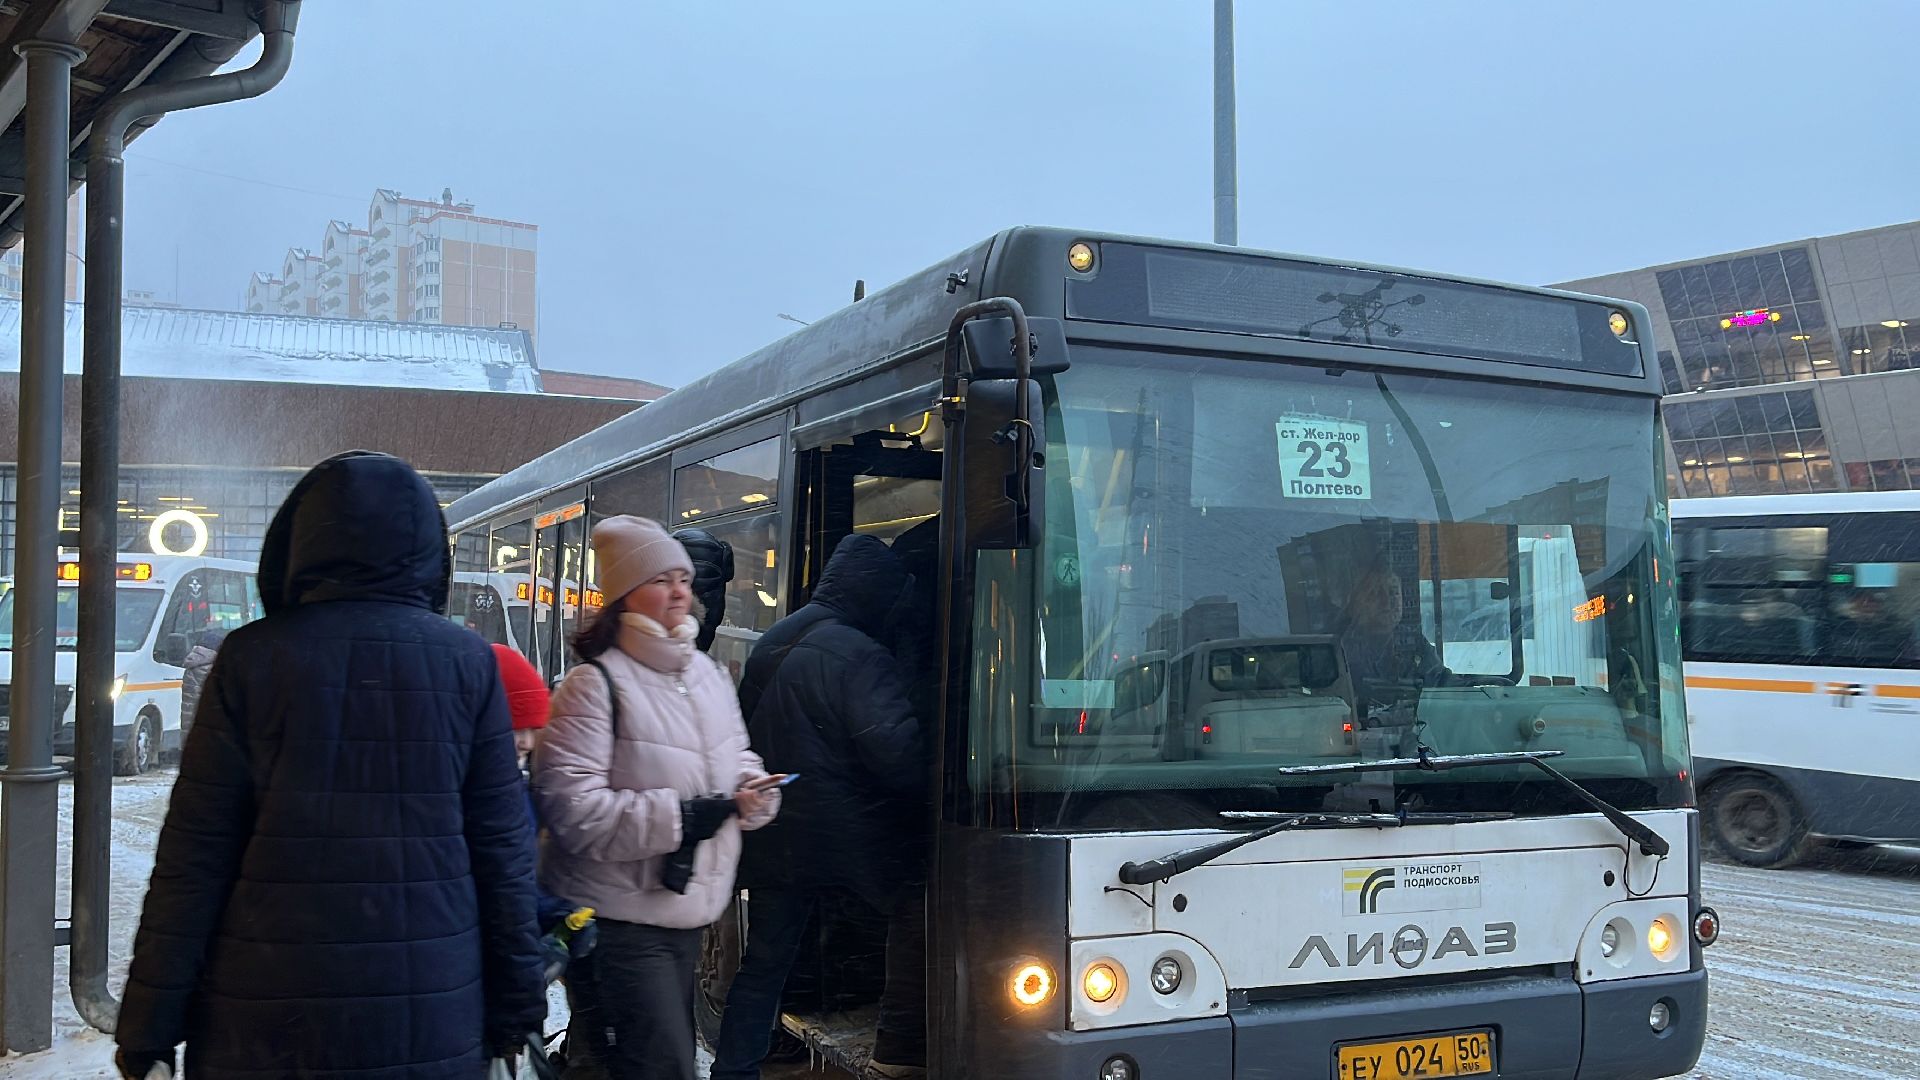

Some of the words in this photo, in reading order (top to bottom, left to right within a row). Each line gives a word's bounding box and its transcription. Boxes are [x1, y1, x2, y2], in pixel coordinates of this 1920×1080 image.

[1280, 429, 1300, 439] ст.
[1302, 427, 1361, 443] Жел-дор
[1296, 440, 1352, 479] 23
[1290, 479, 1363, 496] Полтево
[1403, 864, 1463, 876] ТРАНСПОРТ
[1403, 875, 1480, 889] ПОДМОСКОВЬЯ
[1395, 1042, 1443, 1077] 024
[1457, 1037, 1481, 1061] 50
[1462, 1061, 1481, 1072] RUS
